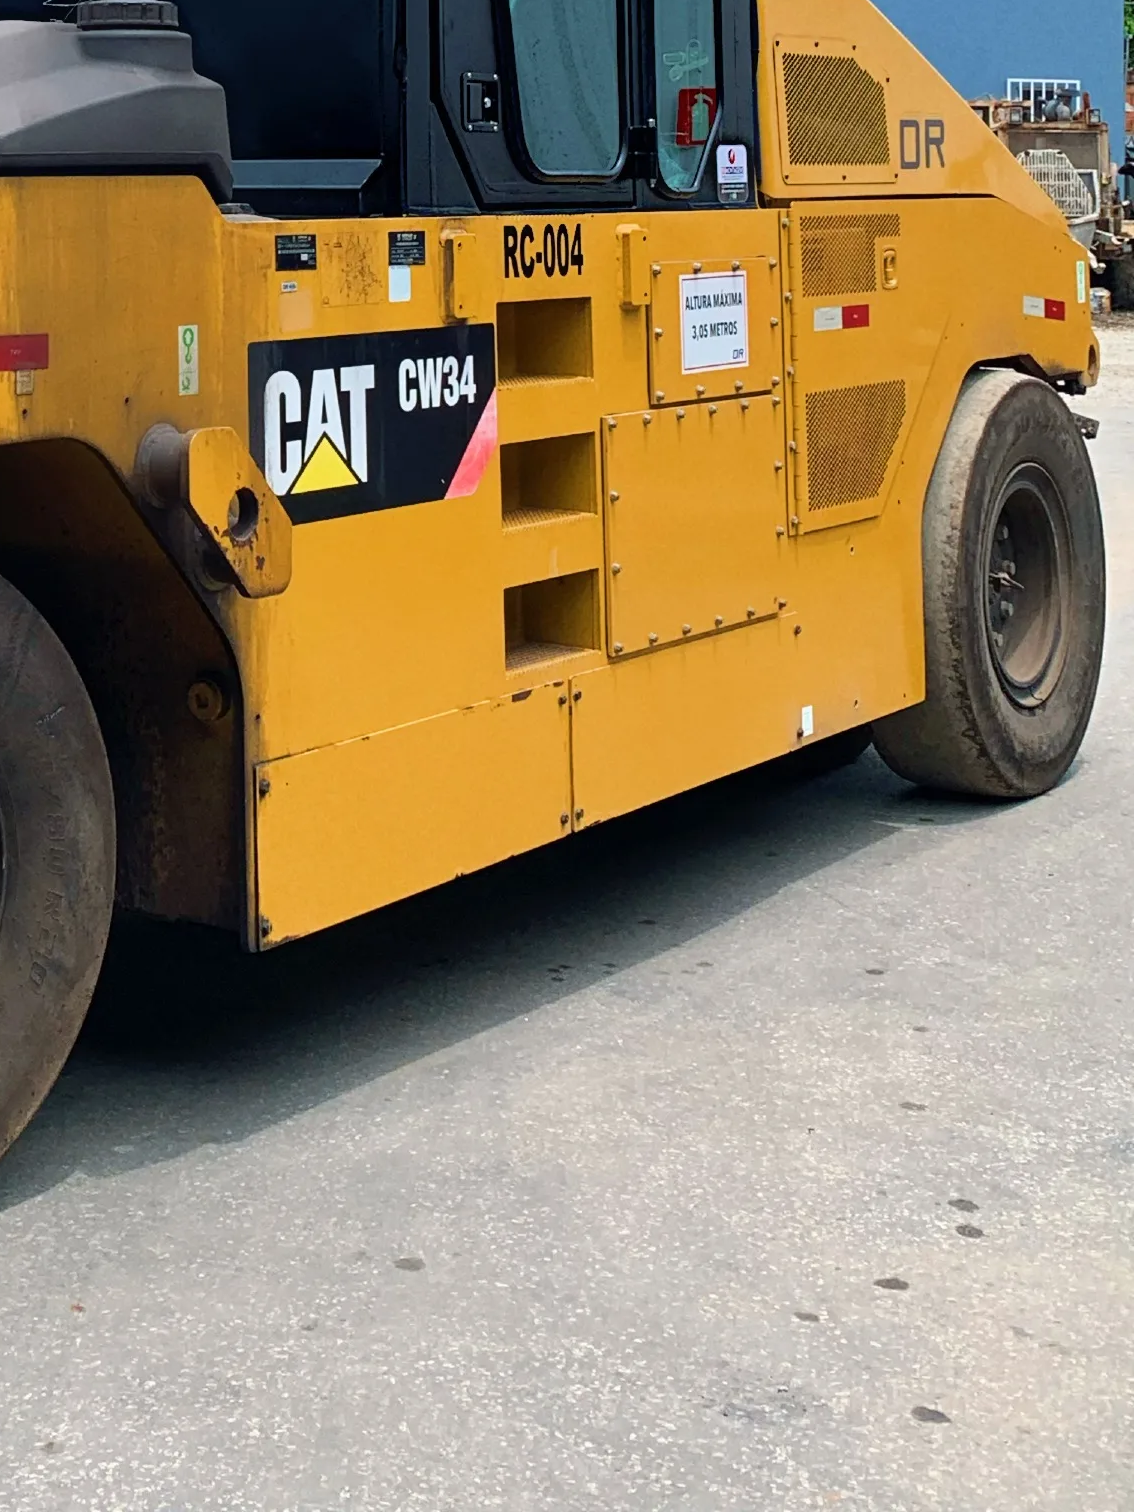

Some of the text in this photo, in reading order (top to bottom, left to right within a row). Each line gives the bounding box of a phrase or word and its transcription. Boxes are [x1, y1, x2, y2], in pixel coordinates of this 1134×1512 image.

[503, 223, 584, 278] RC-004
[685, 290, 743, 311] ALTURA MÁXIMA
[692, 320, 738, 341] 3,05 METROS
[398, 355, 476, 412] CW34
[264, 364, 375, 495] CAT
